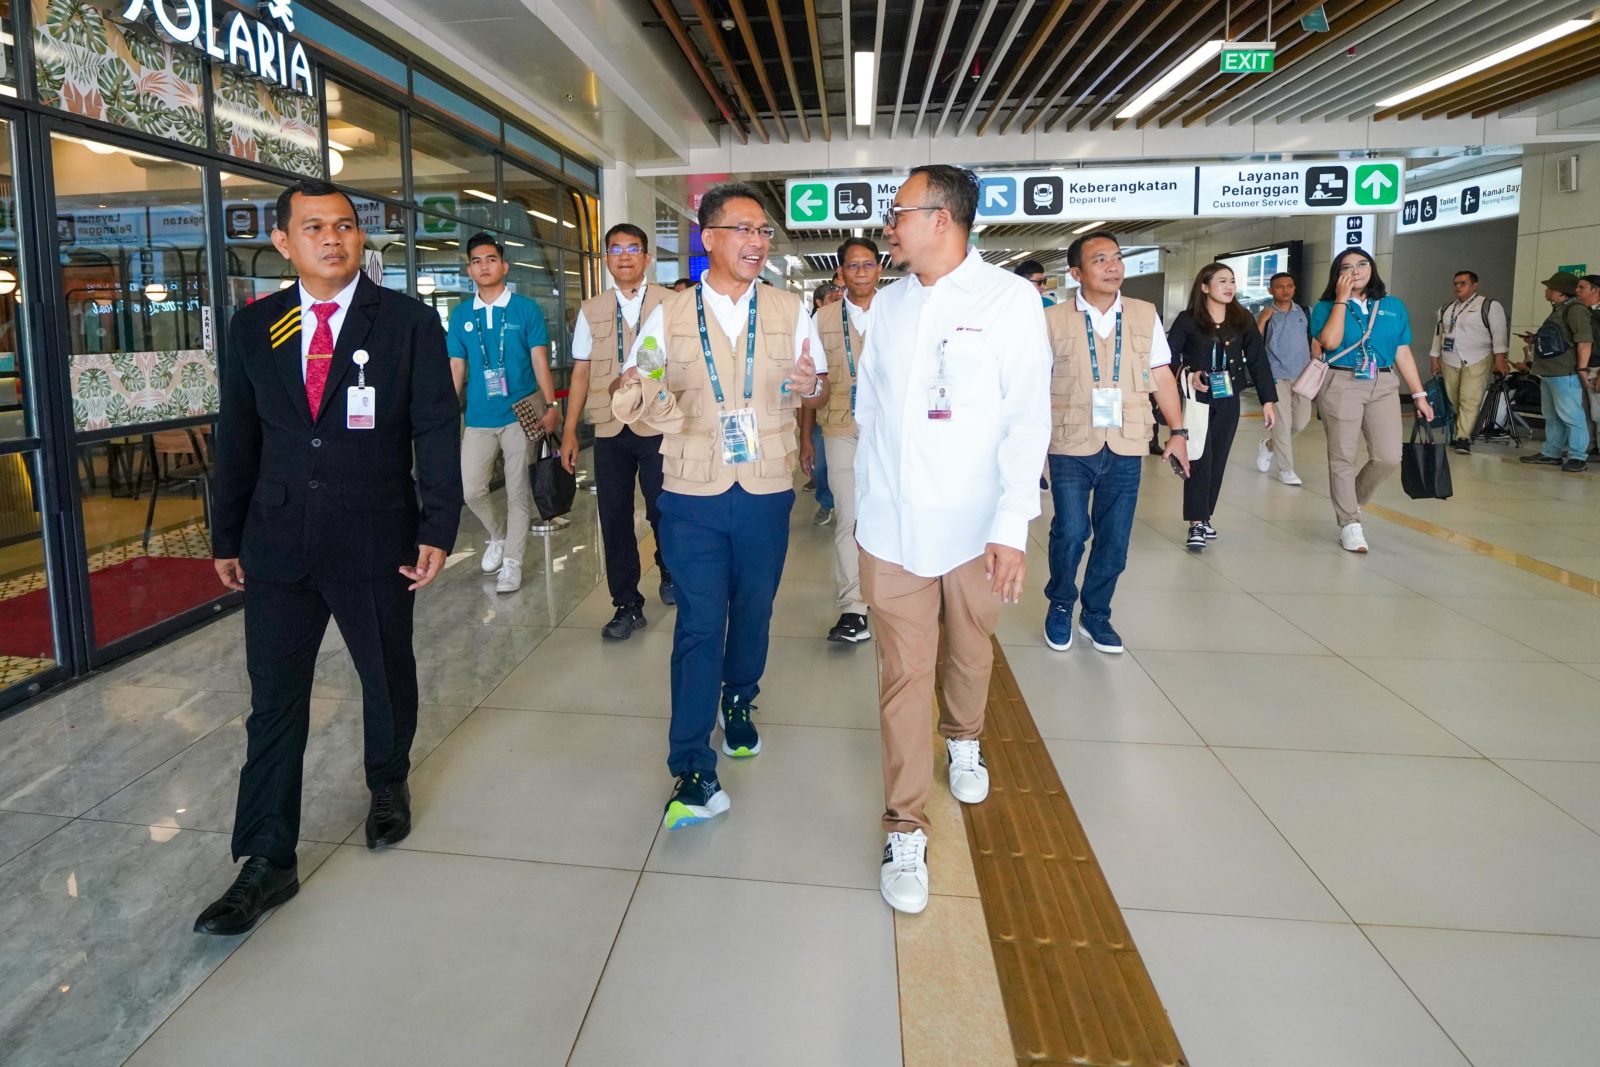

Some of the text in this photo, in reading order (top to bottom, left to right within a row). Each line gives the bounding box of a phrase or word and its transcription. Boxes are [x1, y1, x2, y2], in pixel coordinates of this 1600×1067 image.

[1225, 53, 1270, 70] EXIT
[1238, 171, 1299, 184] Layanan
[1069, 181, 1178, 194] Keberangkatan
[1222, 185, 1299, 197] Pelanggan
[1482, 187, 1505, 198] Kamar
[1069, 196, 1117, 205] Departure
[1212, 199, 1299, 208] Customer Service
[1440, 197, 1457, 206] Toilet
